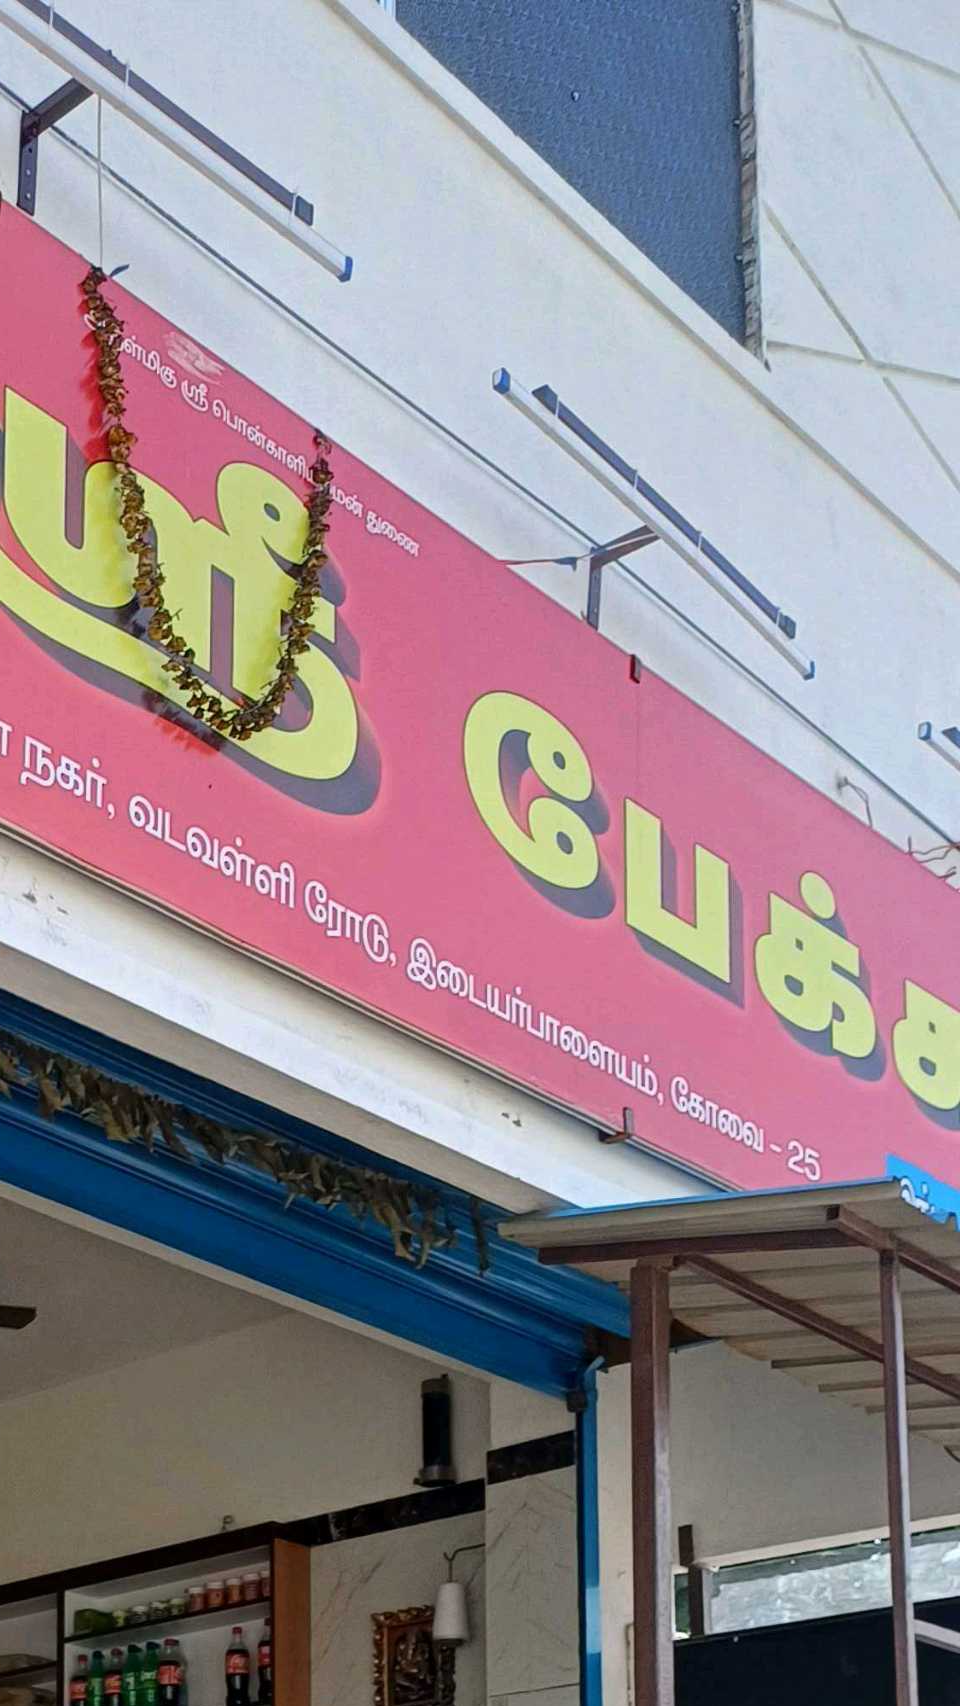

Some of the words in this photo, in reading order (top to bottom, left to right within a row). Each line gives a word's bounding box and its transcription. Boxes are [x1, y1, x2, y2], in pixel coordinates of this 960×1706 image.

[366, 511, 420, 557] துணை
[20, 736, 115, 819] நகர்,
[128, 795, 295, 908] வடவள்ளி
[304, 881, 397, 967] ரோடு,
[406, 937, 665, 1106] இடையர்பாளையம்,
[670, 1076, 765, 1153] கோவை
[786, 1140, 821, 1182] 25
